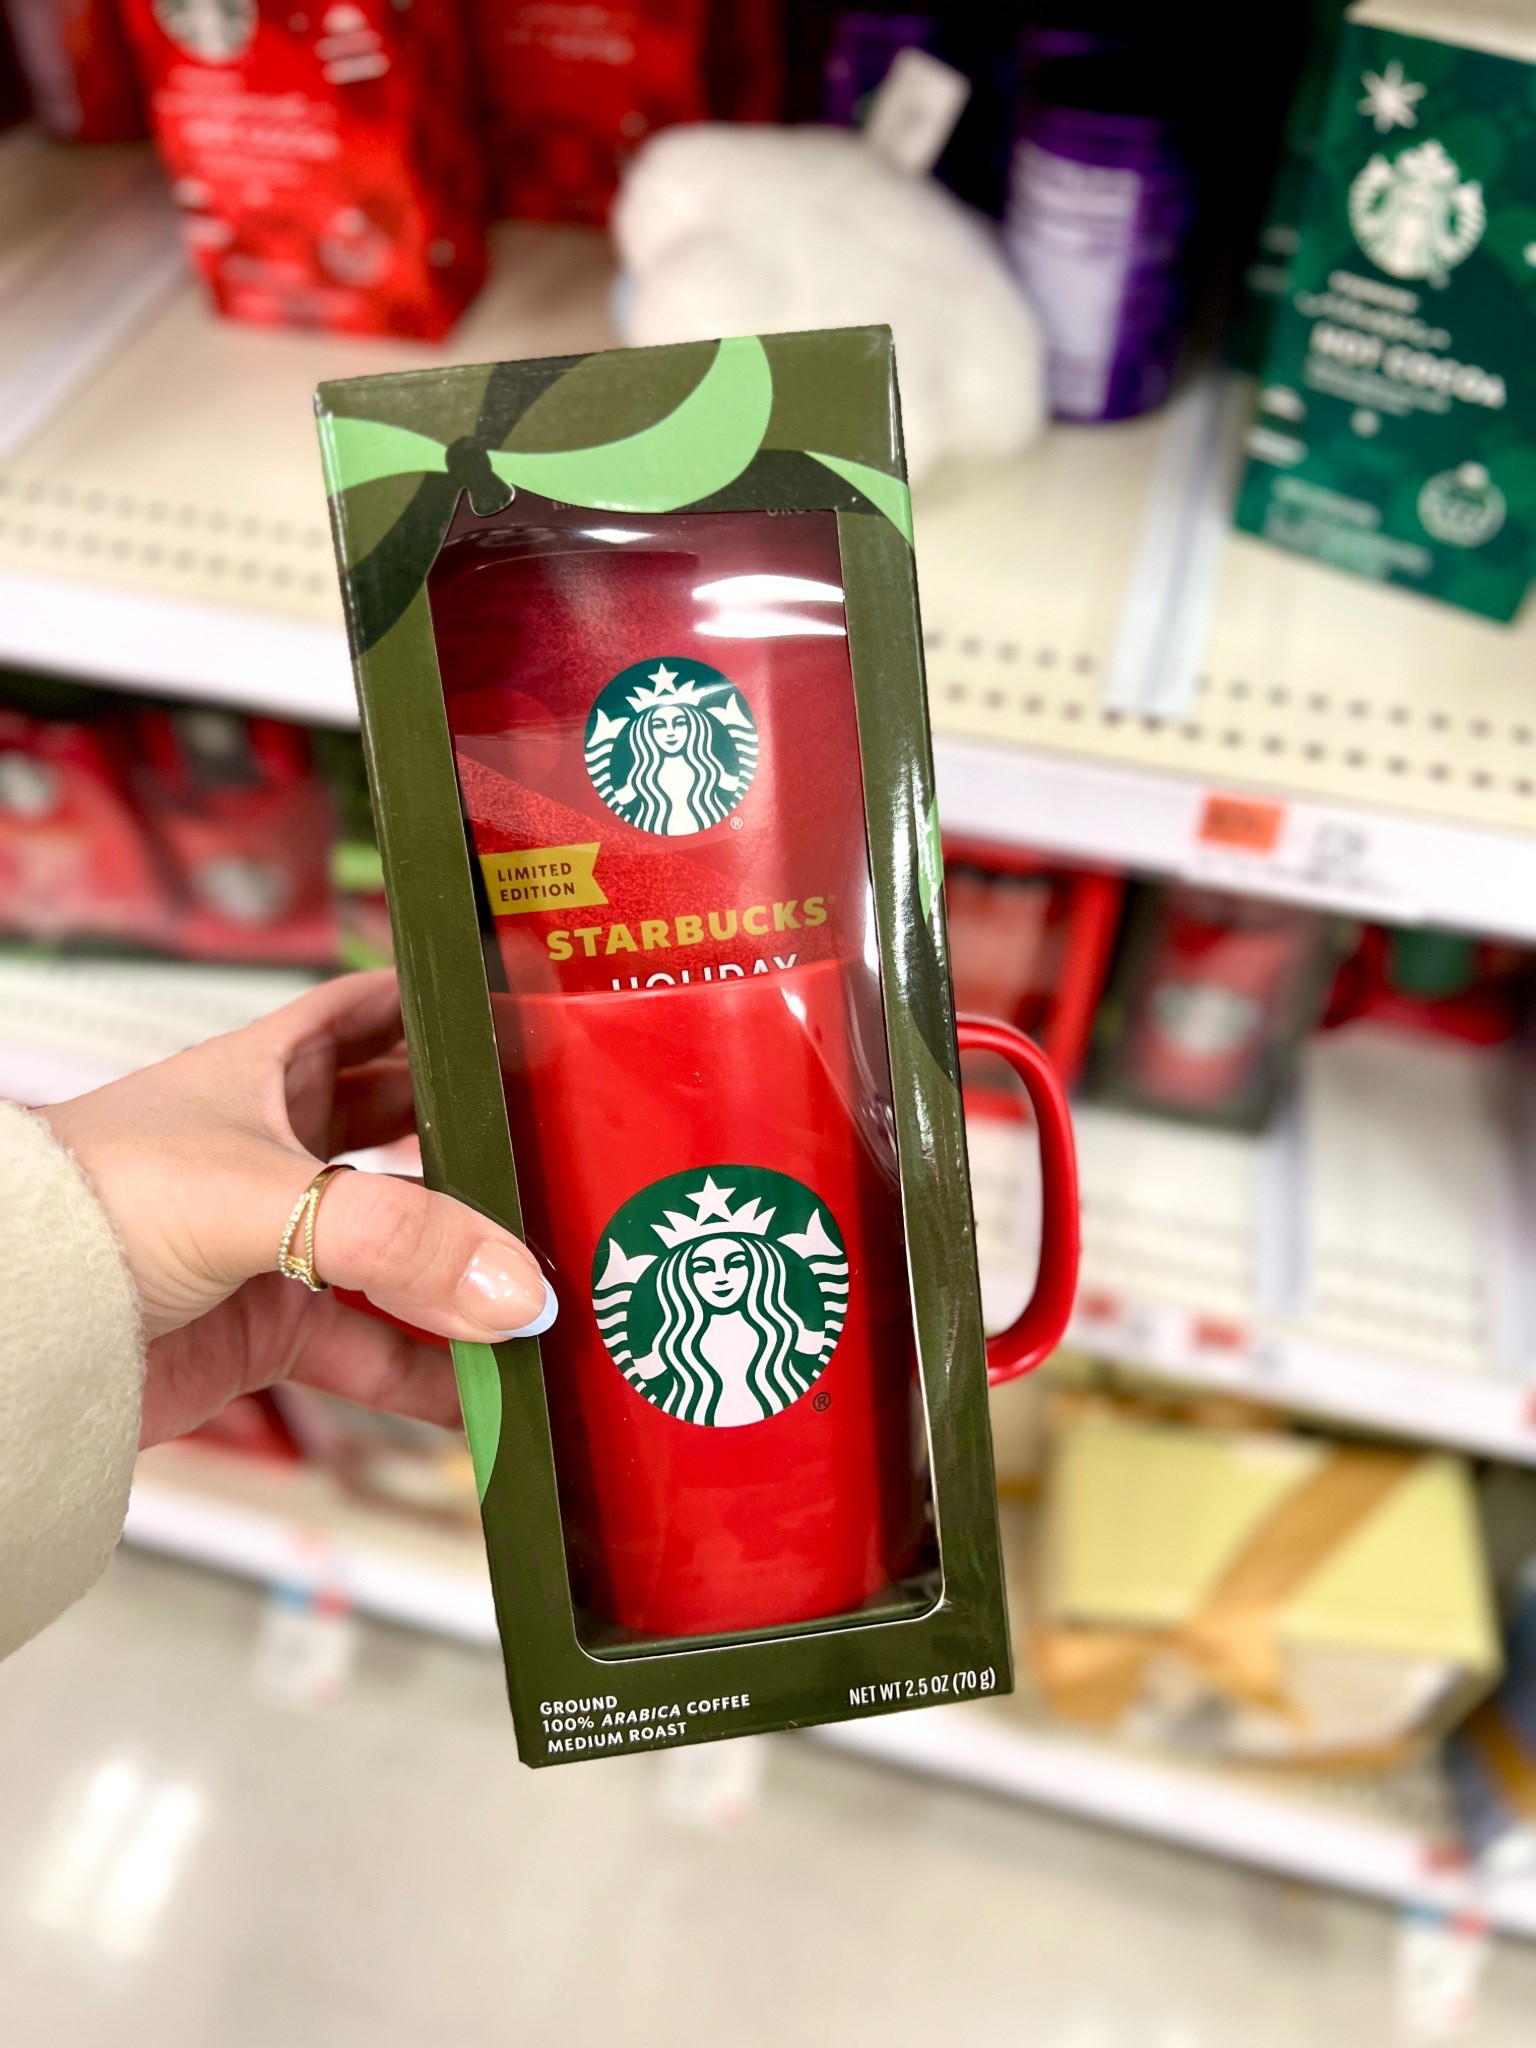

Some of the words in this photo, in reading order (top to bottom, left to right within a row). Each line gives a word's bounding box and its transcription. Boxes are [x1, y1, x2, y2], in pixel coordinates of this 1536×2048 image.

[497, 862, 572, 882] LIMITED
[500, 882, 575, 902] EDITION
[546, 896, 828, 961] STARBUCKS
[849, 1685, 877, 1706] NET
[880, 1681, 902, 1701] WT
[904, 1677, 928, 1698] 2.5
[931, 1674, 949, 1694] OZ
[952, 1670, 977, 1695] (70
[979, 1666, 996, 1691] g)
[540, 1695, 618, 1715] GROUND
[542, 1715, 595, 1733] 100%
[601, 1704, 681, 1727] ARABICA
[686, 1693, 750, 1715] COFFEE
[548, 1731, 623, 1753] MEDIUM
[629, 1721, 687, 1742] ROAST
